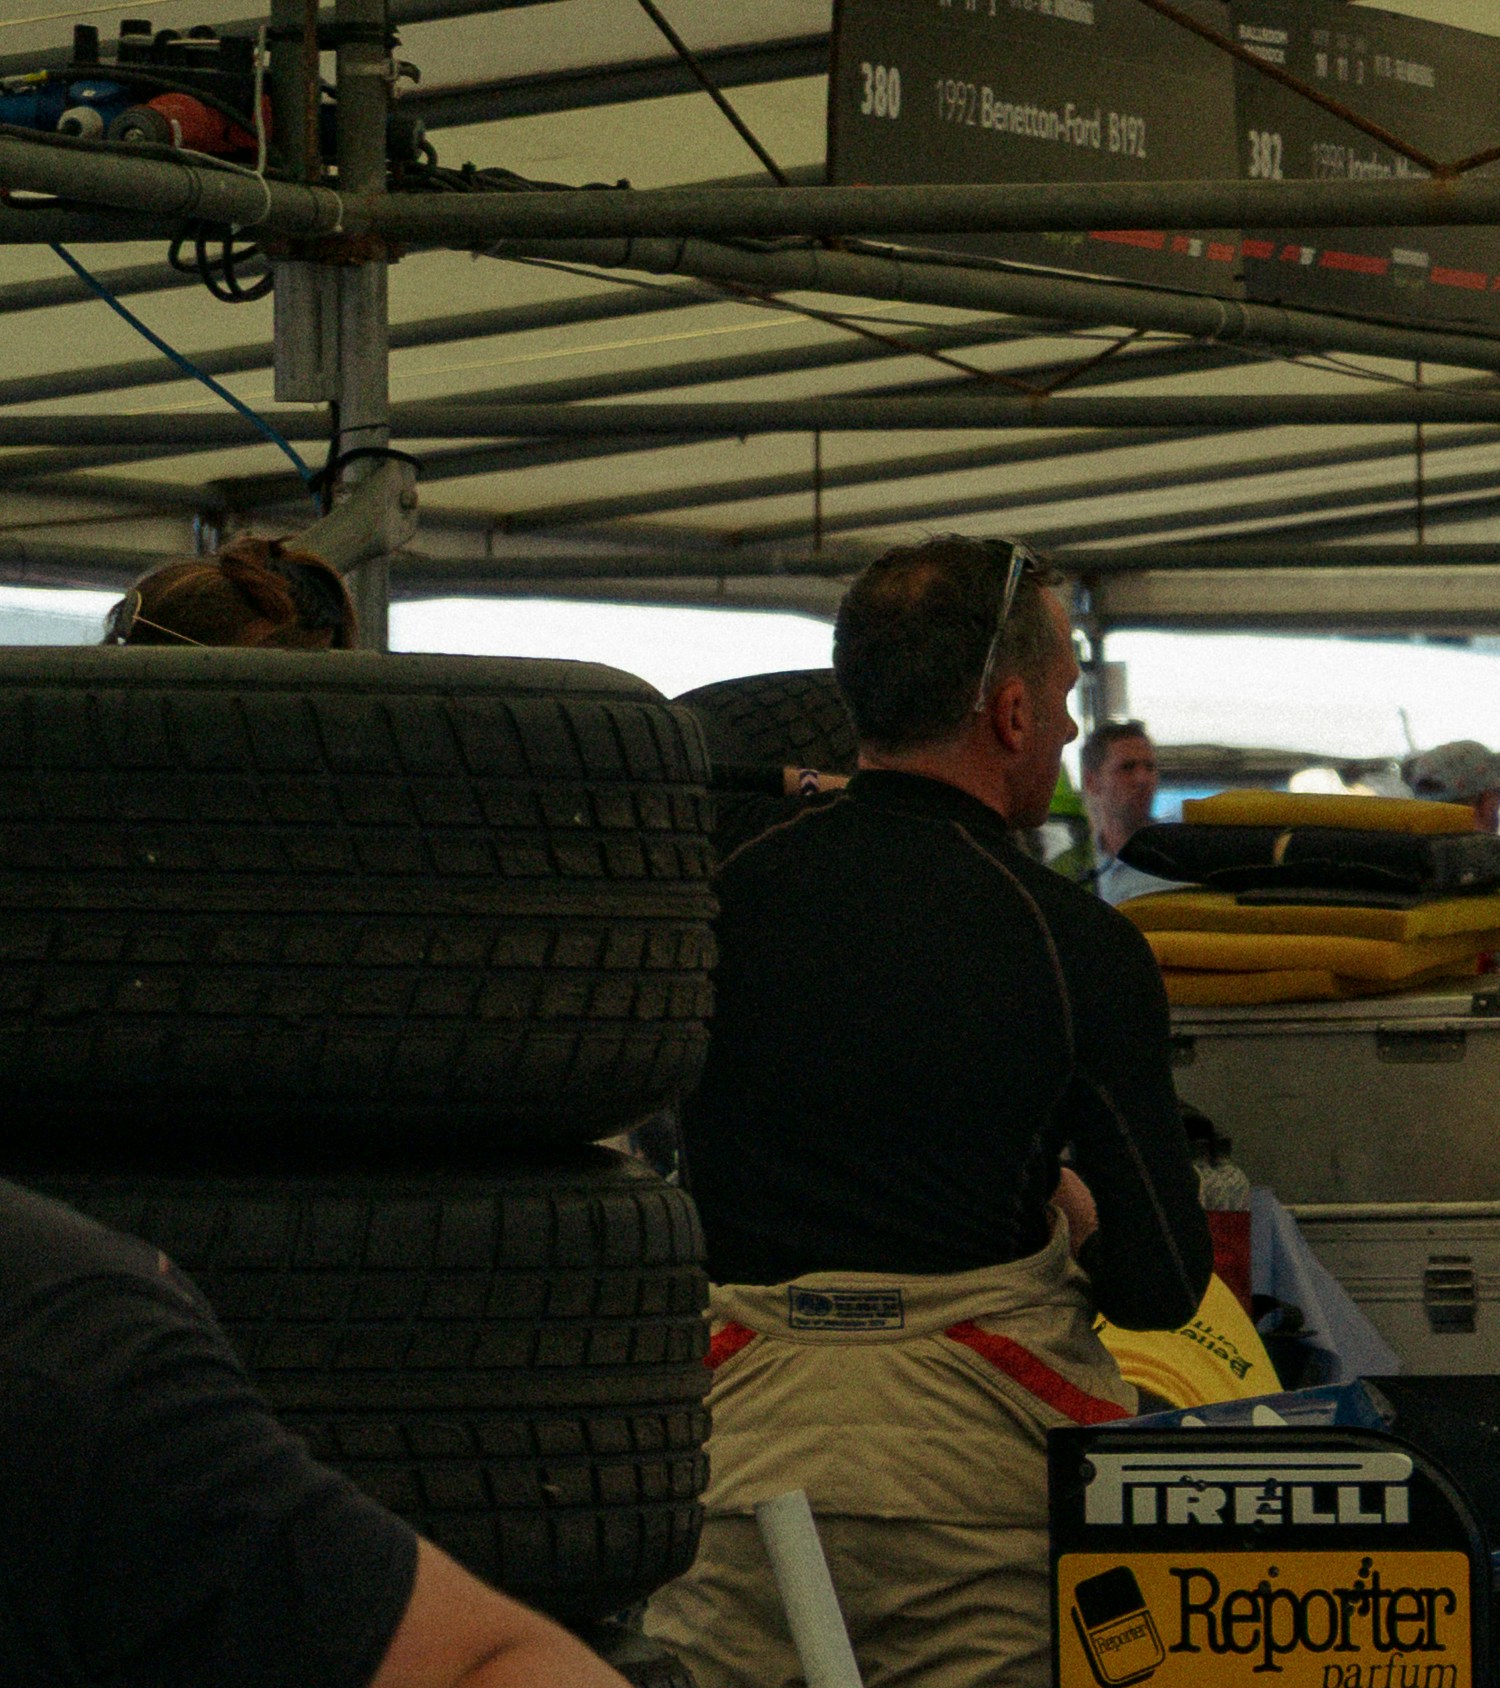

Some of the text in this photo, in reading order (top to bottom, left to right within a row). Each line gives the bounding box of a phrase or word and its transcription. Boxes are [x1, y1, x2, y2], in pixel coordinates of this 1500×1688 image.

[860, 60, 1148, 159] 380 1992 Benetton-Ford B192
[1084, 1452, 1415, 1525] PIRELLI
[1096, 1624, 1149, 1655] Reporter
[1168, 1565, 1458, 1673] Reporter
